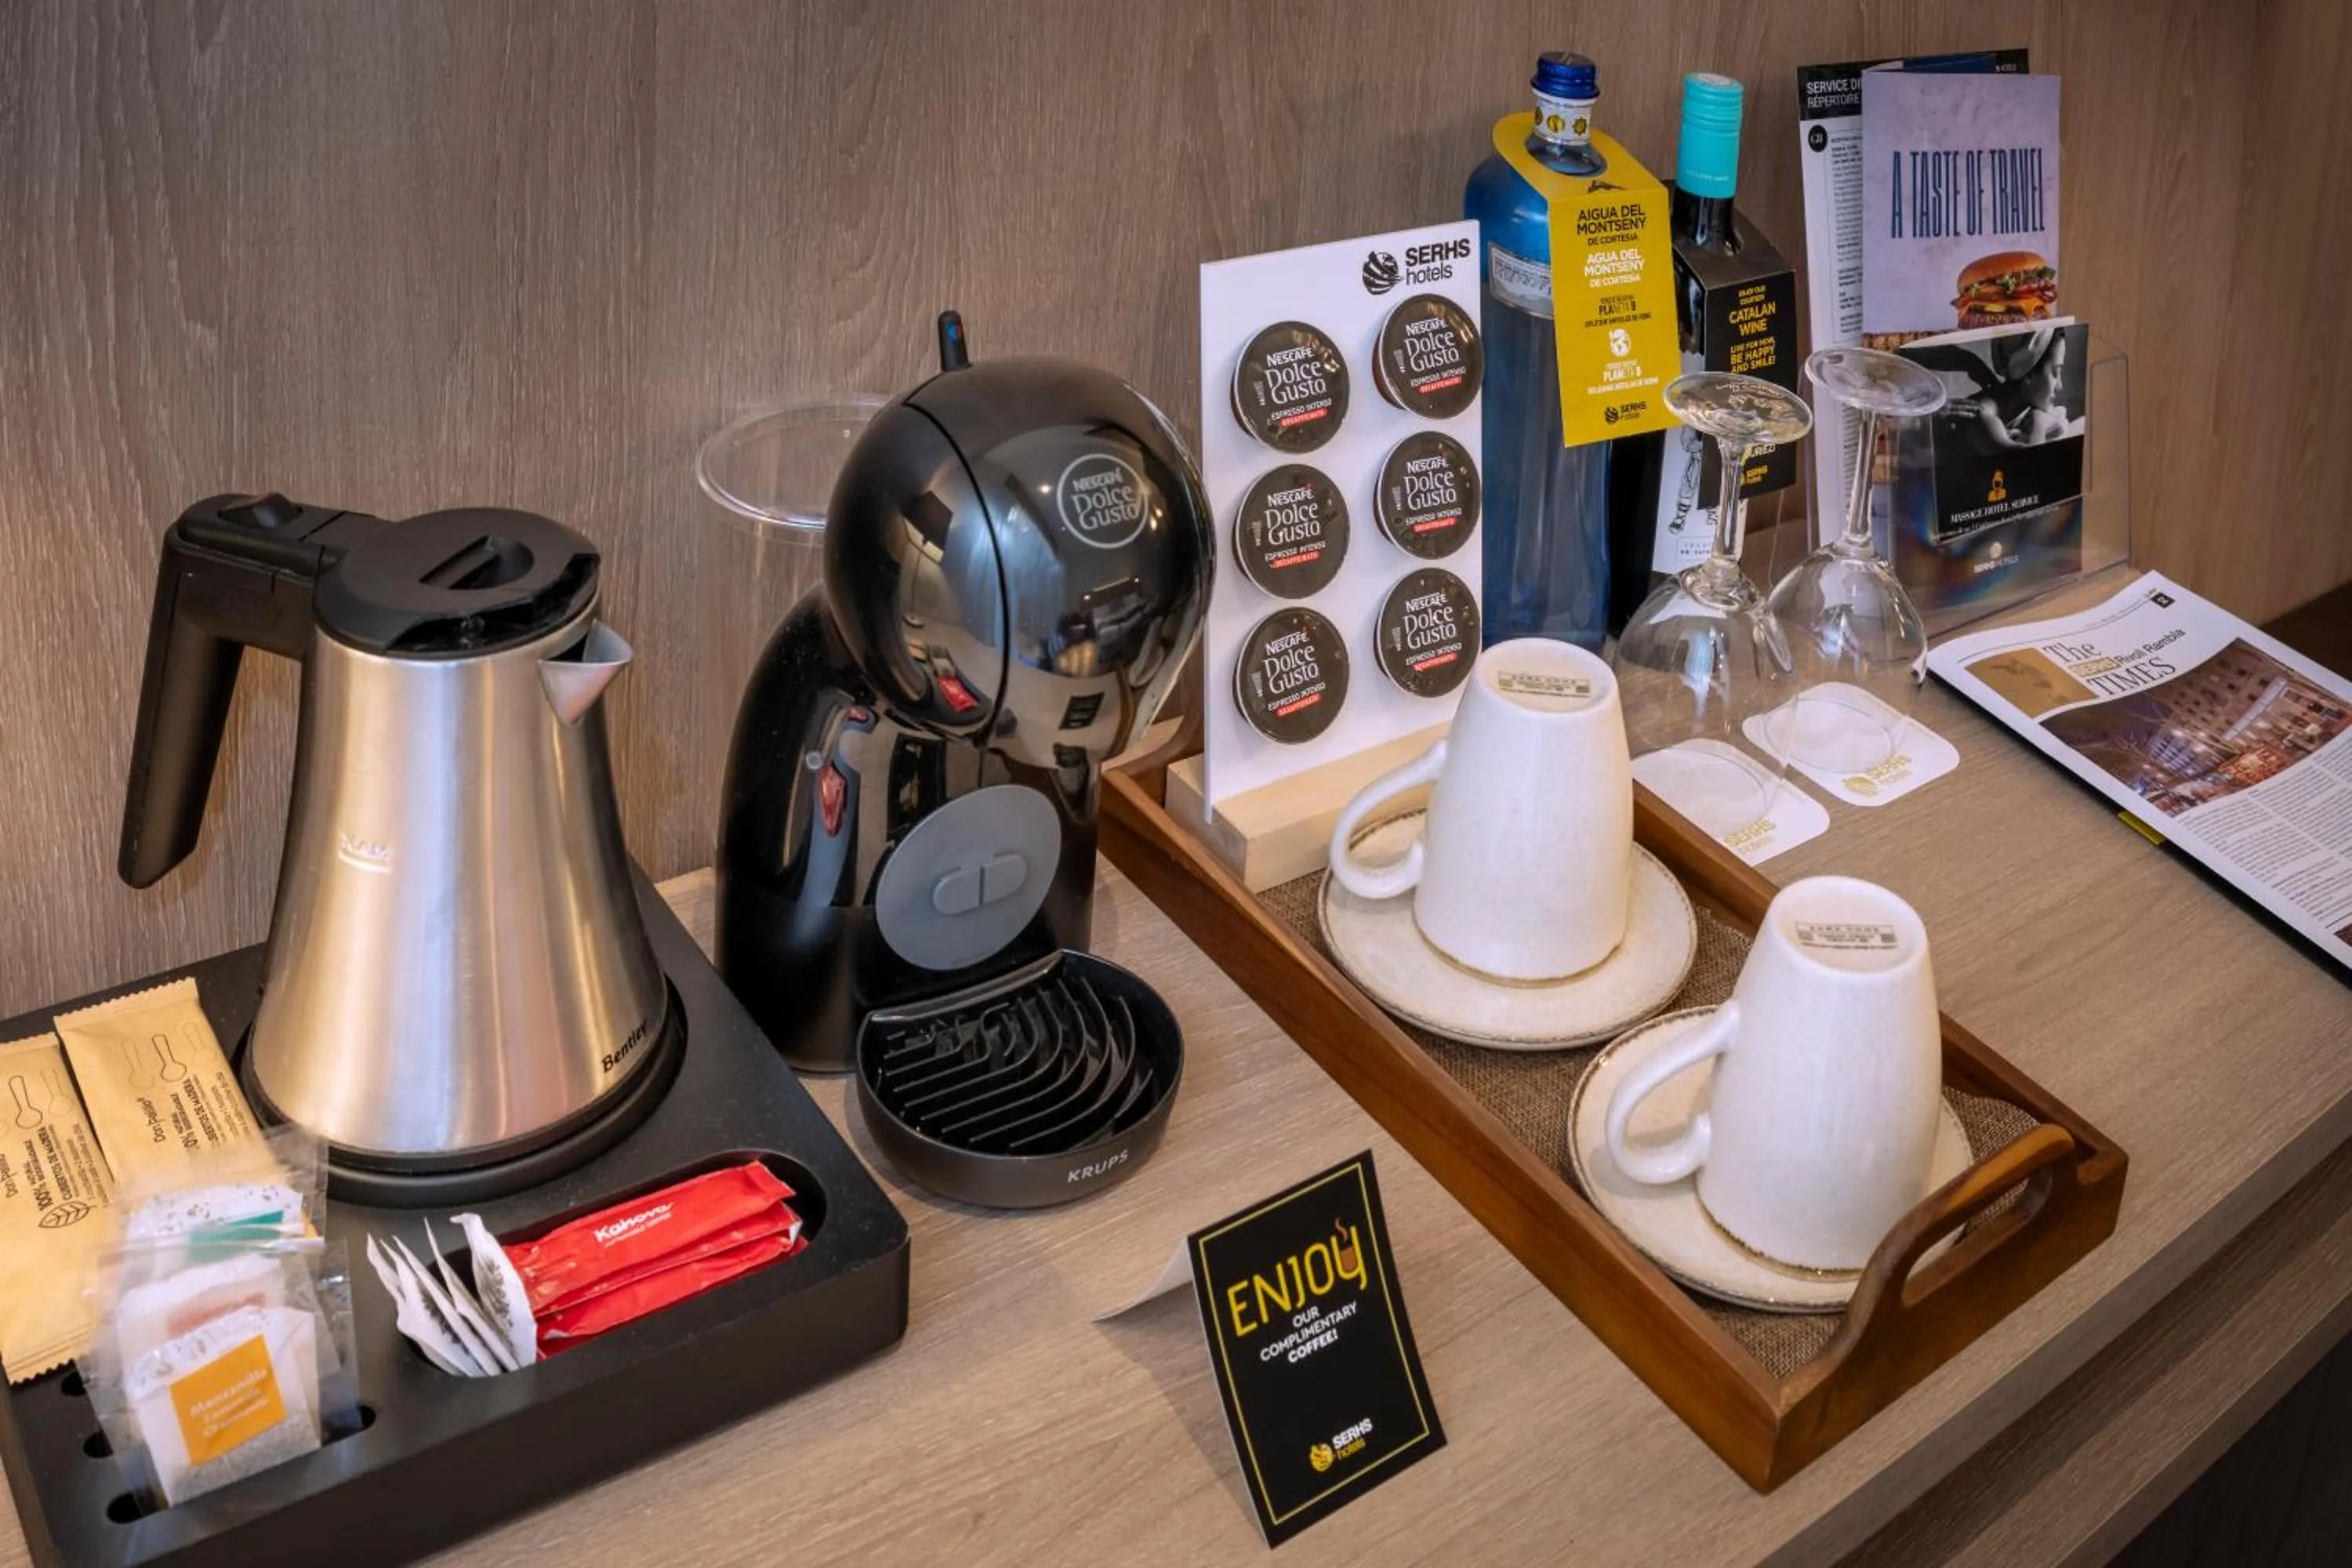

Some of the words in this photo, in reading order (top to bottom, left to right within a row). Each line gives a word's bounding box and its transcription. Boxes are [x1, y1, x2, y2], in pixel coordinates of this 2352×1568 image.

[1806, 79, 1849, 94] SERVICE
[1891, 151, 1903, 239] A
[1910, 150, 1960, 238] TASTE
[1965, 150, 1984, 236] OF
[1989, 147, 2045, 235] TRAVEL
[1578, 206, 1619, 221] AIGUA
[1621, 204, 1645, 217] DEL
[1577, 216, 1647, 236] MONTSENY
[1405, 238, 1471, 267] SERHS
[1587, 250, 1619, 264] AGUA
[1620, 248, 1642, 260] DEL
[1406, 261, 1453, 285] hotels
[1584, 258, 1645, 277] MONTSENY
[1729, 300, 1776, 325] CATALAN
[1739, 318, 1768, 336] WINE
[1403, 332, 1455, 357] Dolce
[1745, 347, 1774, 361] HAPPY
[1410, 347, 1460, 372] Gusto
[1730, 361, 1748, 376] AND
[1264, 361, 1323, 389] Dolce
[1271, 379, 1327, 404] Gusto
[1403, 471, 1454, 494] Dolce
[1070, 486, 1135, 513] Dolce
[1407, 488, 1456, 510] Gusto
[1079, 503, 1139, 531] Gusto
[1263, 503, 1318, 528] Dolce
[1268, 520, 1321, 545] Gusto
[1403, 606, 1454, 634] Dolce
[1407, 624, 1456, 649] Gusto
[2143, 629, 2186, 653] Rambla
[1261, 645, 1316, 677] Dolce
[2042, 641, 2101, 662] The
[1269, 662, 1319, 694] Gusto
[2085, 656, 2176, 695] TIMES
[1067, 1149, 1128, 1184] KRUPS
[1292, 1305, 1320, 1327] OUR
[1259, 1299, 1358, 1362] COMPLIMENTARY
[1287, 1327, 1339, 1363] COFFEE!
[1332, 1417, 1373, 1450] SERHS
